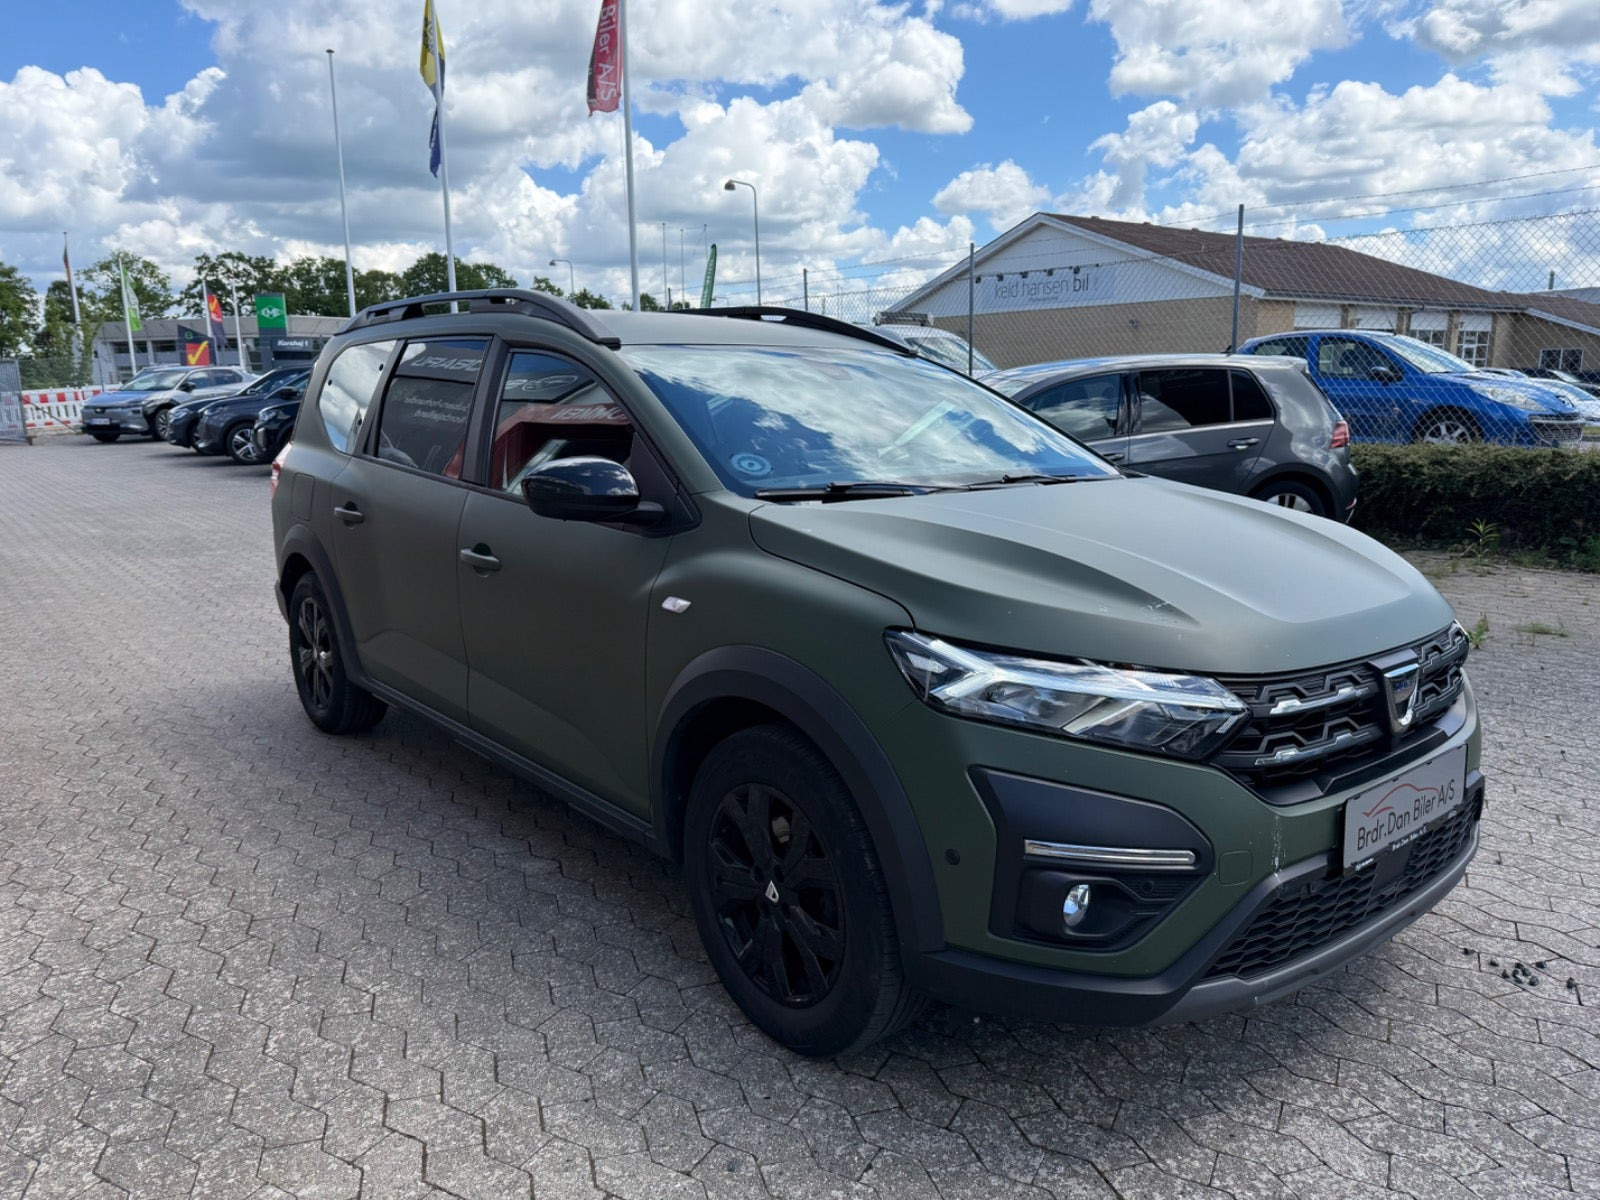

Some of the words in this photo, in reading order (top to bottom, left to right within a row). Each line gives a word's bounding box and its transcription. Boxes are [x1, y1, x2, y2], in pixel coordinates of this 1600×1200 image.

[599, 5, 616, 54] Biler
[598, 63, 617, 101] A/S
[1022, 279, 1068, 297] hansen
[1073, 272, 1089, 292] bil
[1413, 795, 1436, 822] Biler
[1437, 779, 1455, 807] A/S
